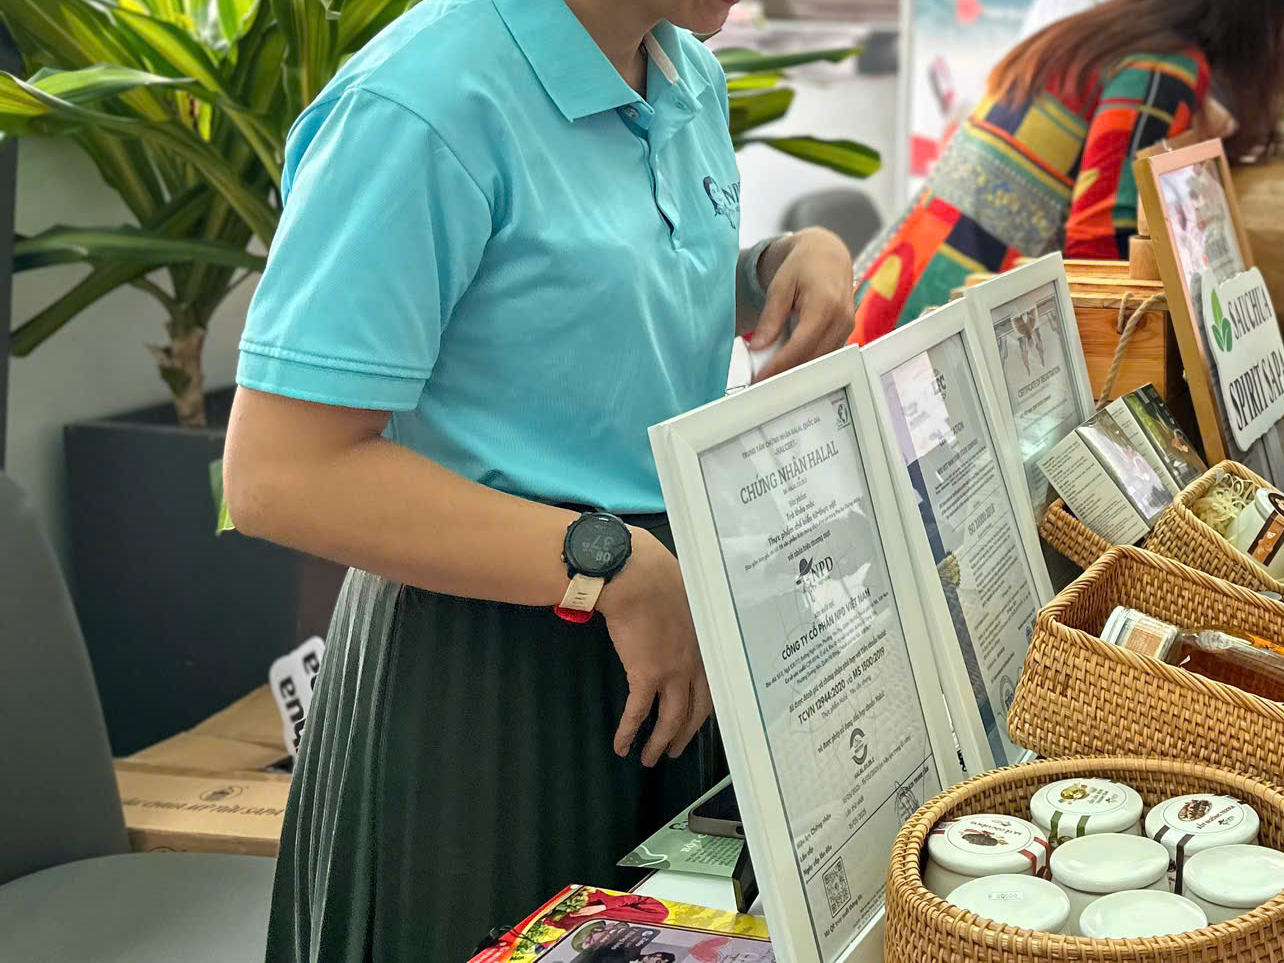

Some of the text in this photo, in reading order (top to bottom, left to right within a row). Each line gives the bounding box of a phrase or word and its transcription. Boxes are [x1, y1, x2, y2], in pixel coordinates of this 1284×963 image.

[1229, 363, 1268, 430] SPIRIT
[740, 472, 777, 504] CHỨNG
[777, 456, 807, 485] NHẬN
[807, 440, 839, 469] HALAL
[812, 555, 834, 577] NPD
[782, 640, 800, 660] CÔNG
[800, 633, 808, 646] TY
[809, 622, 818, 640] CỔ
[857, 587, 871, 603] NAM
[798, 704, 815, 724] TCVN
[815, 679, 845, 710] 12944:2020
[852, 666, 861, 679] MS
